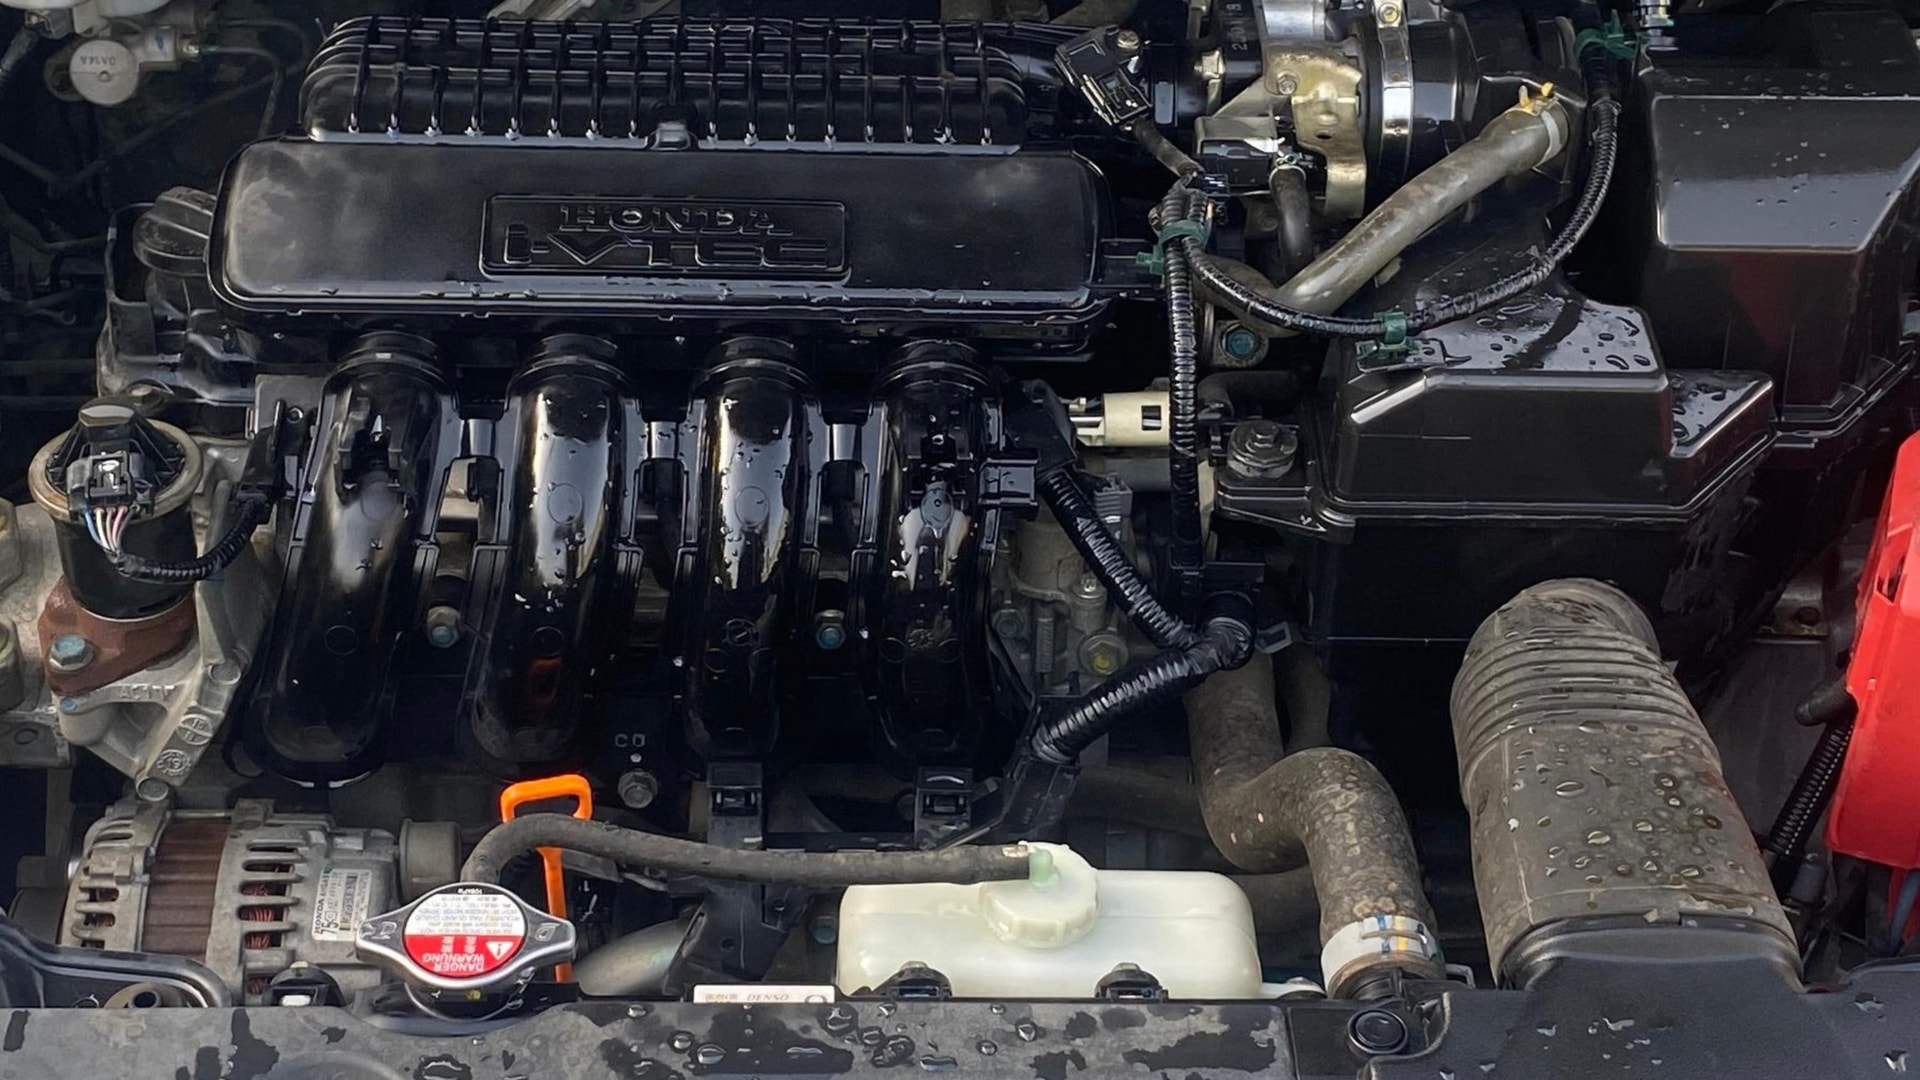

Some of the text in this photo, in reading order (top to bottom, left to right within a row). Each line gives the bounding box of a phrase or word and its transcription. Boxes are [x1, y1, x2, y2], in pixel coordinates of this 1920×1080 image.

[559, 205, 794, 236] HONDA
[314, 898, 324, 934] HONDA
[422, 953, 484, 963] WARNUNG
[433, 962, 484, 972] DANGER
